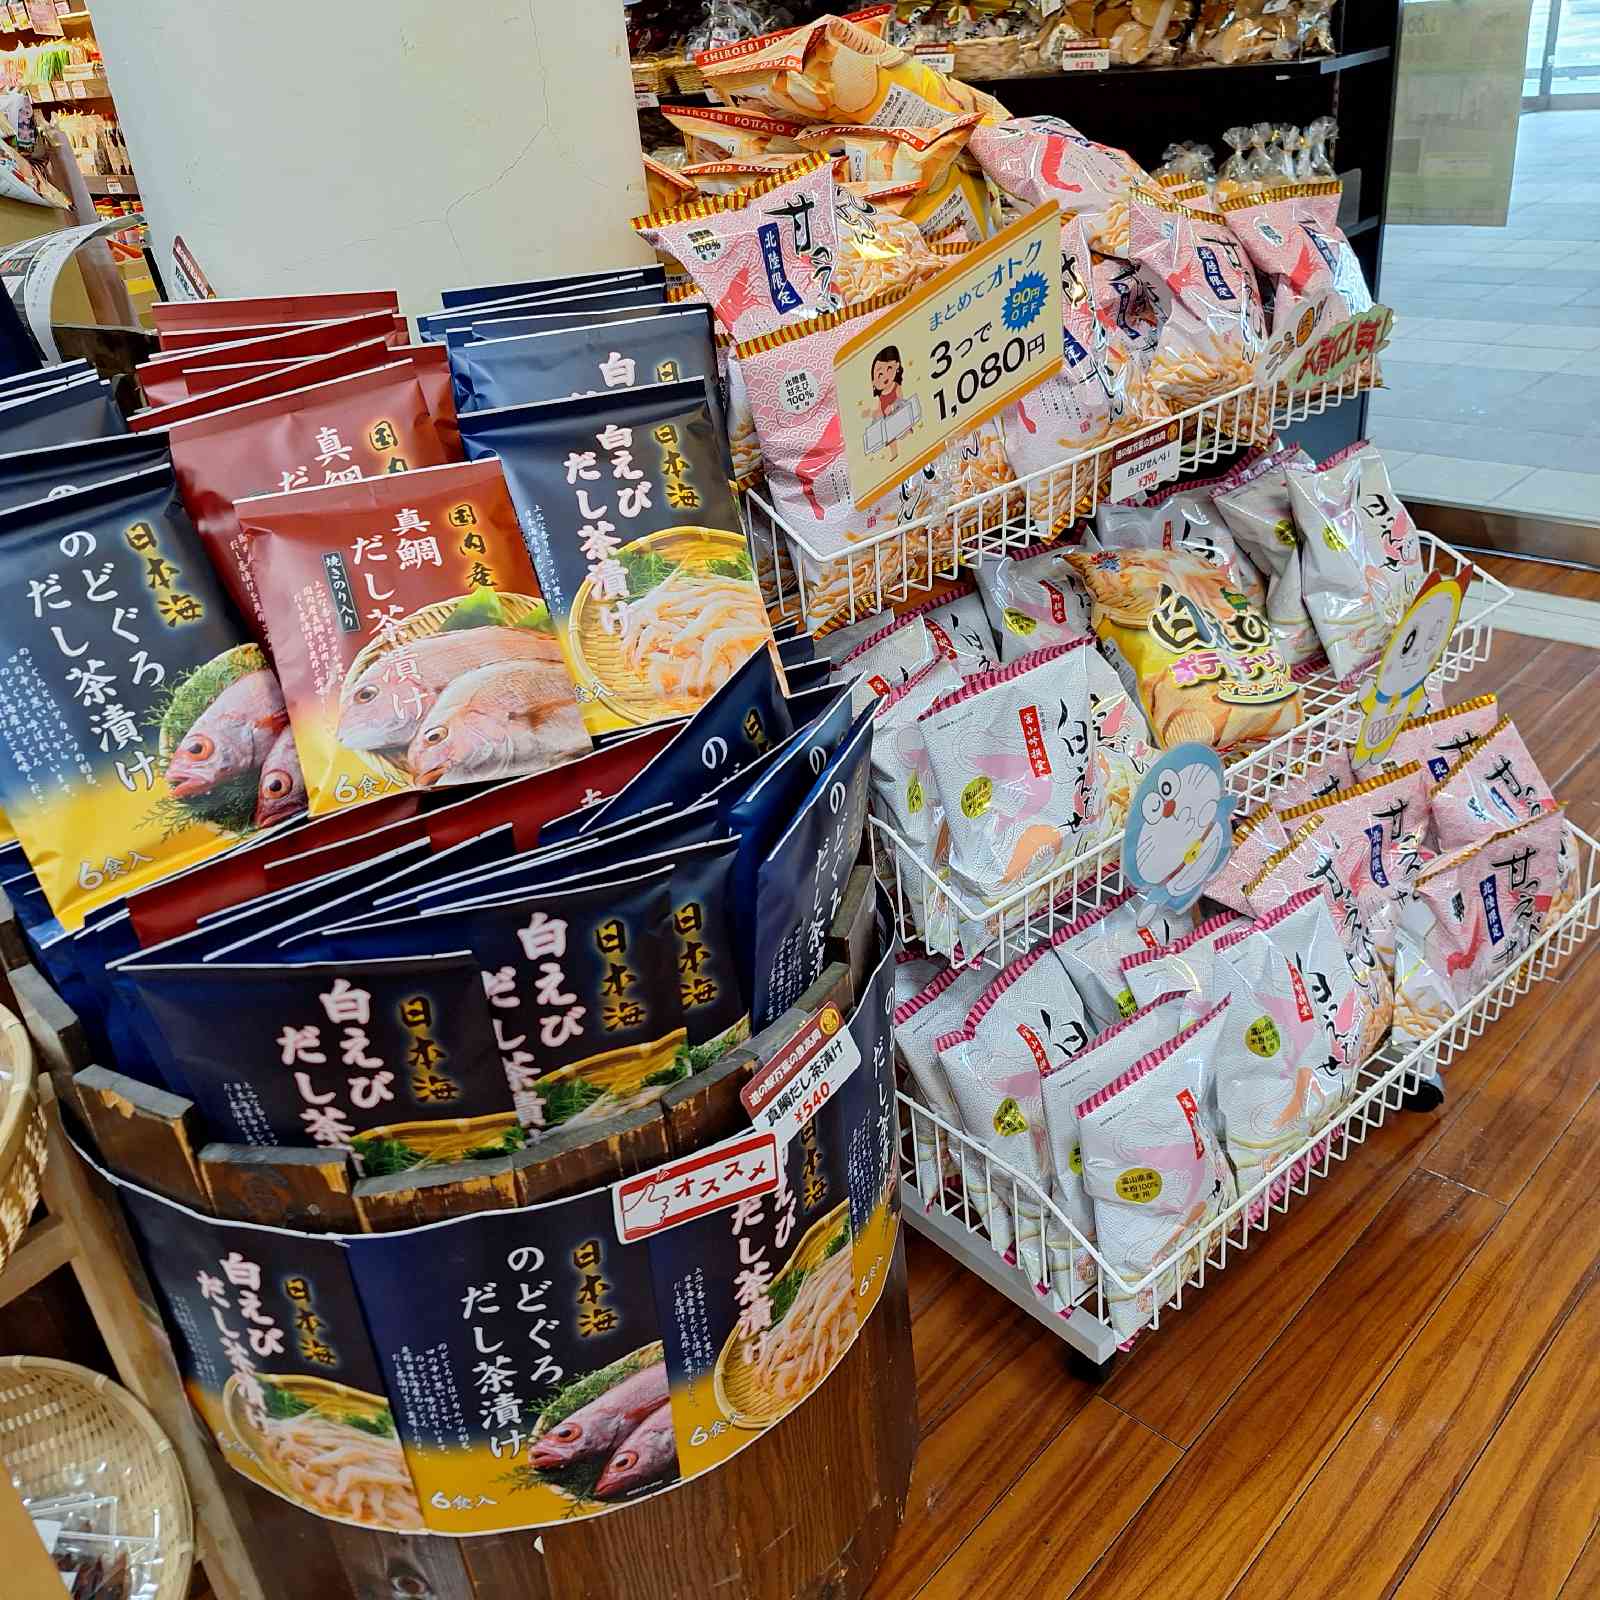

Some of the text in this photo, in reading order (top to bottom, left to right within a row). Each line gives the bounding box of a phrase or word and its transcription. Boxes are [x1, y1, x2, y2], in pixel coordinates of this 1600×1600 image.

[703, 40, 761, 63] SHIROEBI
[670, 107, 729, 123] SHIROEBI
[763, 230, 798, 305] 北陸限定
[930, 239, 1043, 332] まとめてオトク
[1009, 302, 1038, 323] OFF
[1012, 286, 1041, 307] 90円
[929, 320, 993, 381] 3つで
[933, 333, 1046, 422] 1,080円
[786, 390, 815, 407] 100%
[595, 423, 654, 519] 白えび
[654, 423, 700, 509] 日本海
[122, 520, 204, 628] 日本海
[391, 507, 443, 571] 真鯛
[450, 503, 499, 588] 国内産
[562, 451, 636, 635] だし茶漬け
[59, 530, 166, 688] のどぐろ
[325, 554, 356, 628] 焼きのり入り
[350, 534, 430, 722] だし茶漬け
[26, 572, 156, 793] だし茶漬け
[334, 773, 409, 803] 6食入
[76, 848, 155, 891] 6食入
[516, 910, 587, 1048] 白えび
[595, 918, 647, 1032] 日本海
[673, 902, 720, 1010] 日本海
[318, 977, 395, 1109] 白えび
[399, 995, 462, 1104] 日本海
[764, 1041, 847, 1129] 真鯛だし茶漬け
[276, 1024, 366, 1172] だし茶
[674, 1162, 767, 1199] オススメ
[219, 1250, 285, 1358] 白えび
[283, 1276, 338, 1366] 日本海
[506, 1245, 564, 1384] のどぐろ
[572, 1238, 620, 1339] 日本海
[460, 1281, 528, 1460] だし茶漬け
[430, 1490, 498, 1511] 6食入
